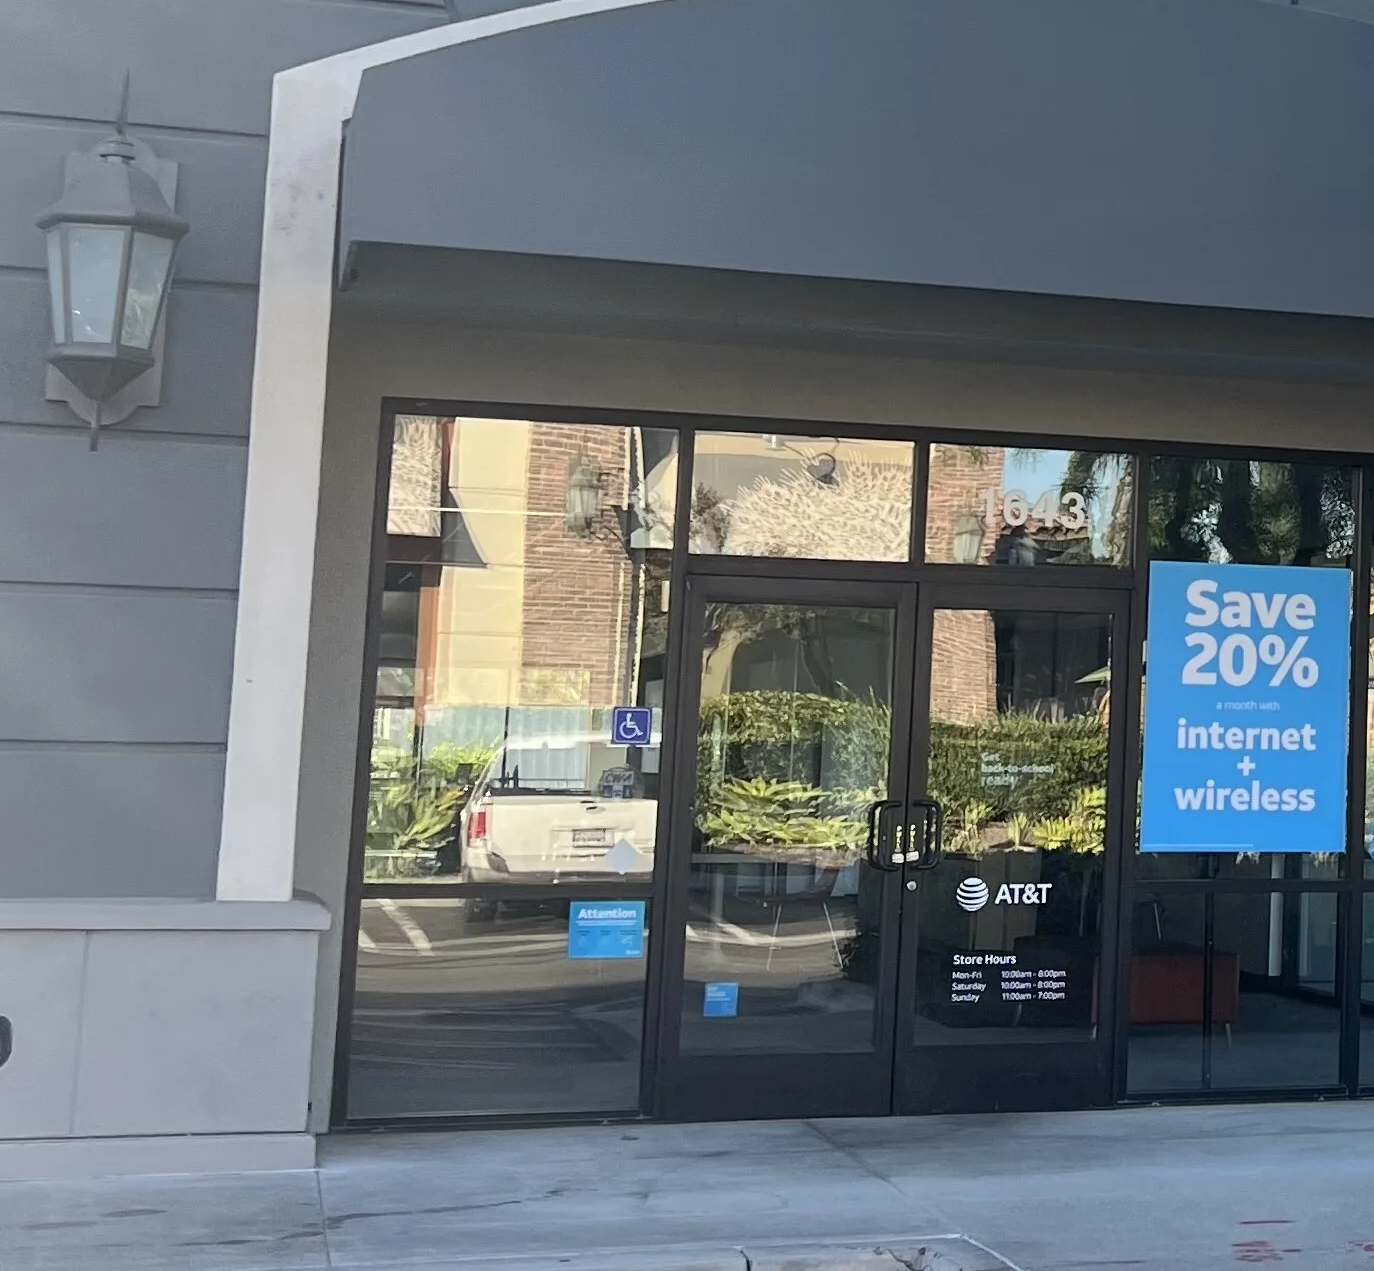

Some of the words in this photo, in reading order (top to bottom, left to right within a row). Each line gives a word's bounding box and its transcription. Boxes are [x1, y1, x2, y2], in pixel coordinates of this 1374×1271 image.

[980, 488, 1086, 530] 1643
[1184, 579, 1317, 631] Save
[1181, 631, 1320, 689] 20%
[1224, 700, 1257, 711] month
[1259, 700, 1281, 711] with
[1177, 717, 1317, 751] internet
[981, 762, 1054, 774] back-to-school
[1173, 779, 1316, 811] wireless
[994, 883, 1053, 905] AT&T
[578, 908, 637, 919] Attention
[953, 954, 983, 965] Store
[984, 954, 1017, 965] Hours
[952, 971, 982, 980] Mon-Fri
[1001, 970, 1032, 979] 10:00am
[951, 981, 987, 991] Saturday
[1001, 981, 1032, 990] 10:00am
[951, 993, 980, 1003] Sunday
[1002, 992, 1032, 1001] 11:00am
[1037, 991, 1066, 1001] 7:00pm
